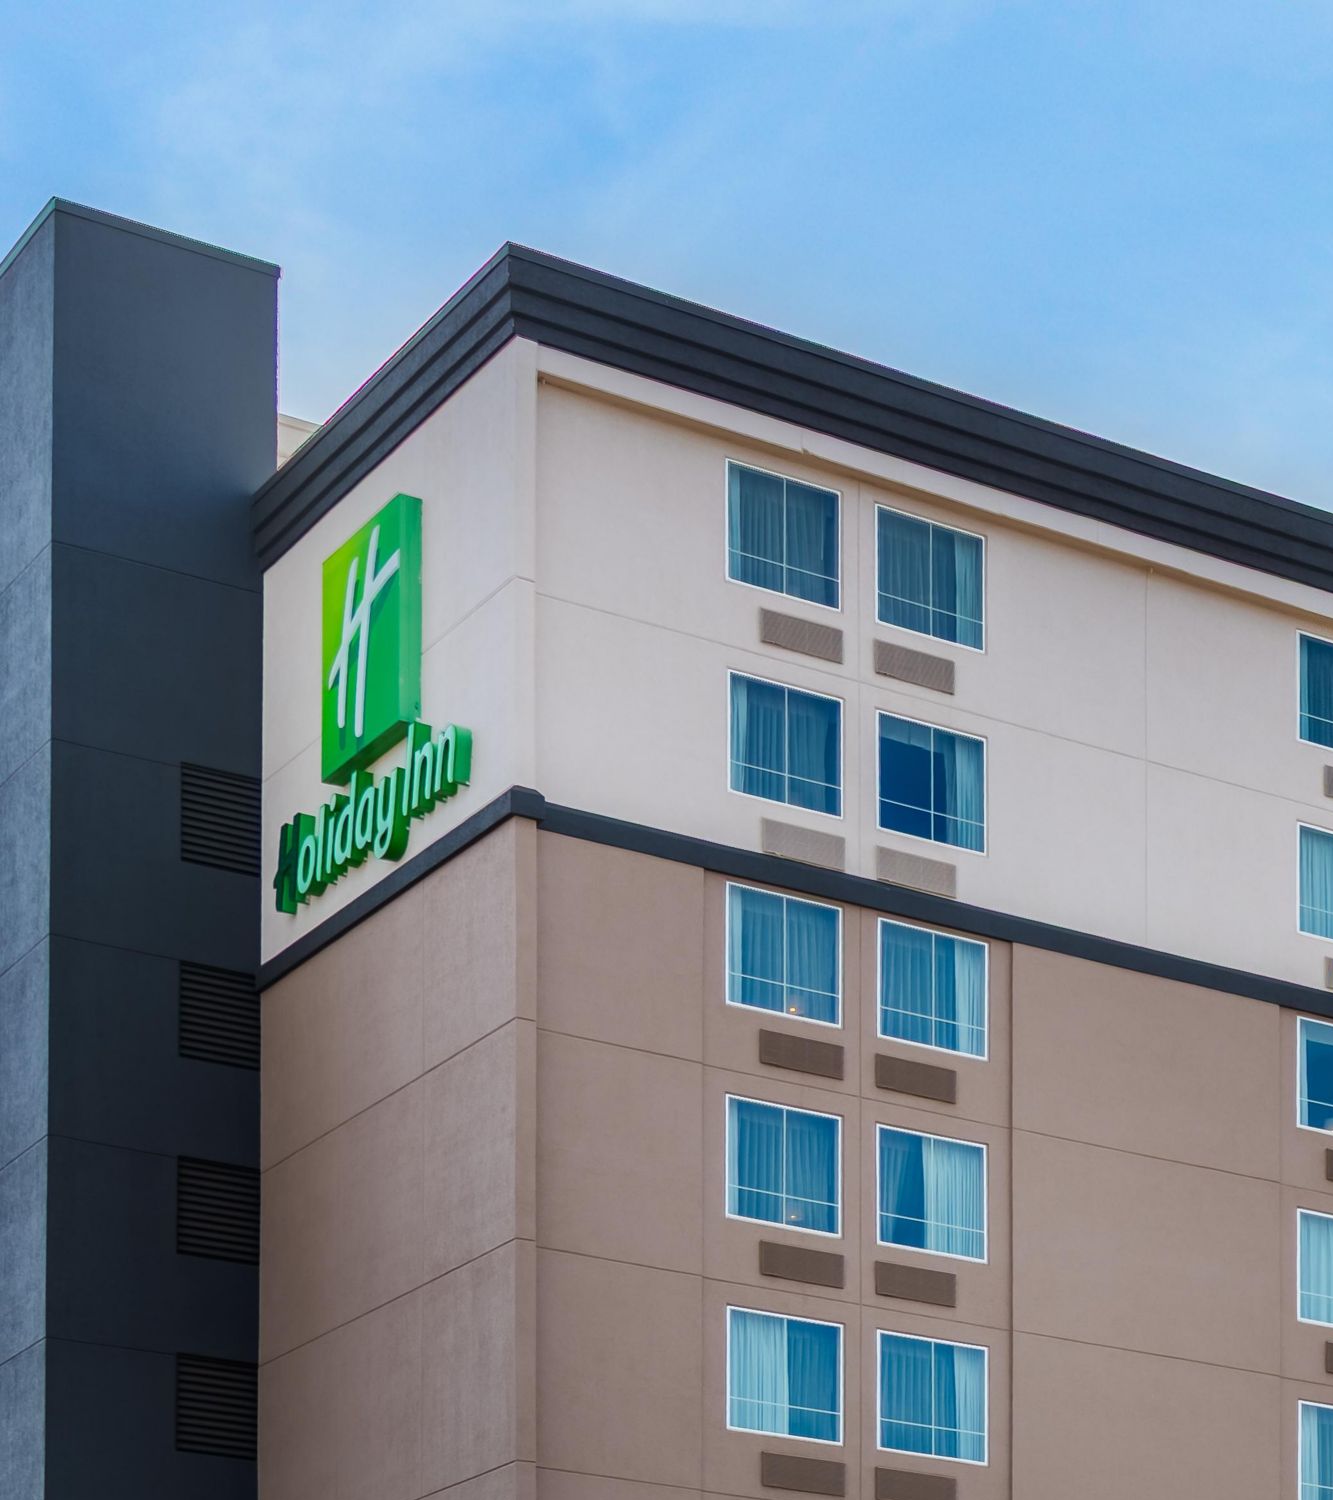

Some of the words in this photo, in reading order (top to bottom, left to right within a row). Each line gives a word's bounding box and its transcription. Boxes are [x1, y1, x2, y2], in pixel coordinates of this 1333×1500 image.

[328, 523, 401, 738] H
[274, 766, 403, 915] Holiday
[402, 721, 462, 818] Inn
